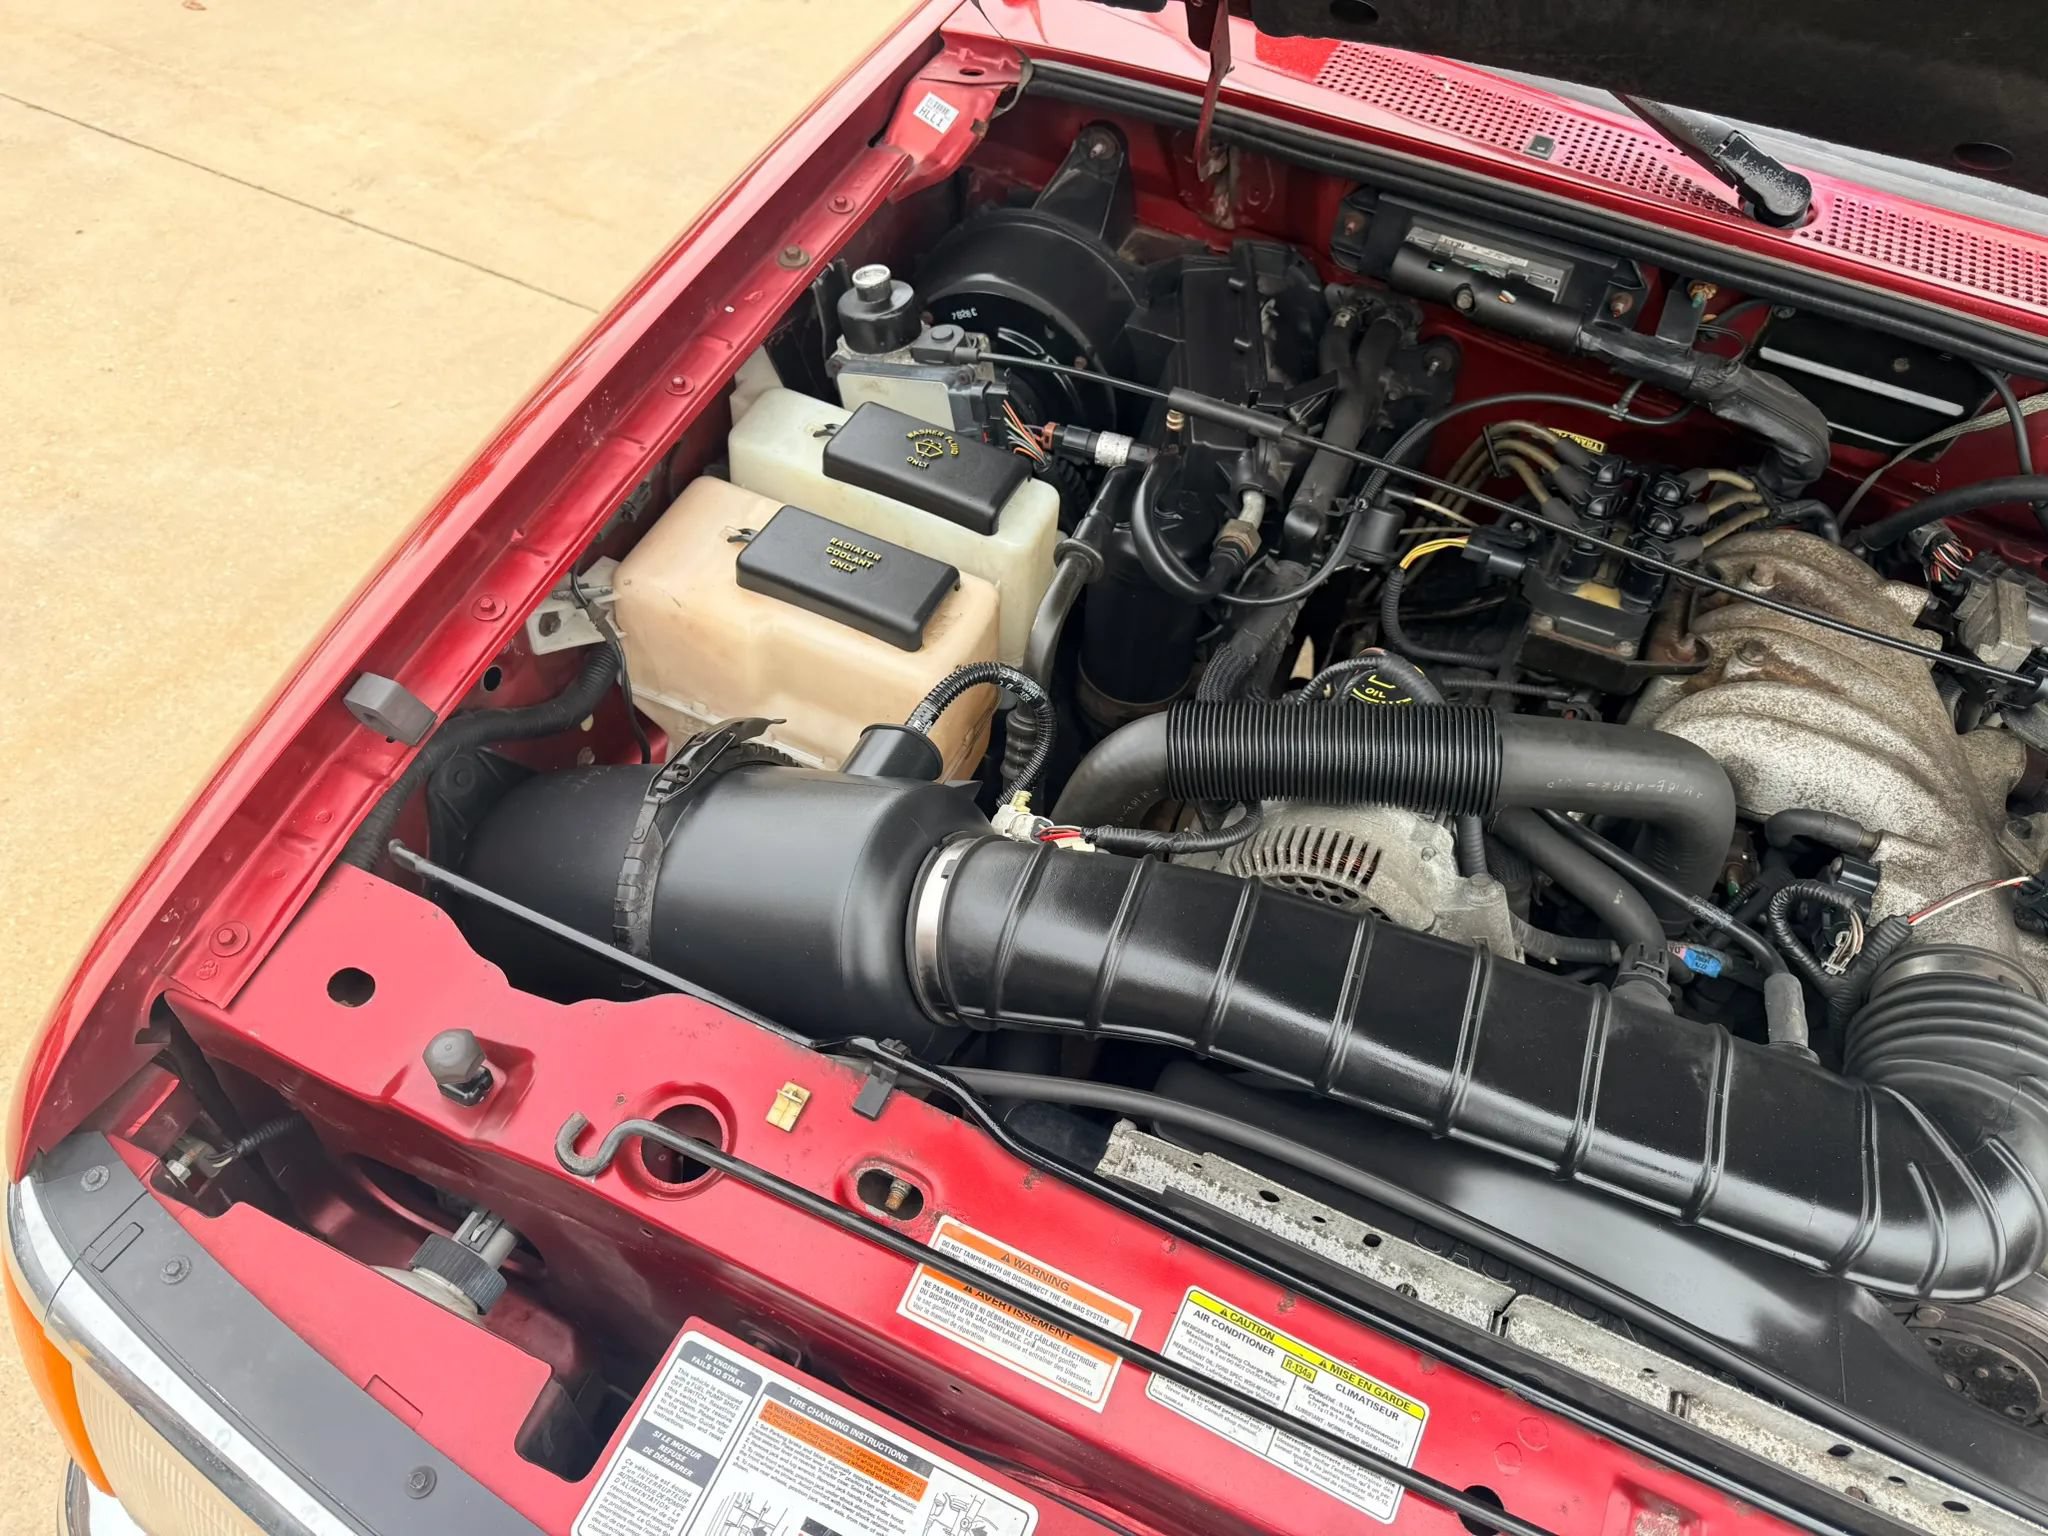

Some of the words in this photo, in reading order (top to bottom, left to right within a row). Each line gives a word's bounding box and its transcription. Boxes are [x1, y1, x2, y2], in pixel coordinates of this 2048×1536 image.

[906, 427, 945, 441] WASHER
[944, 434, 960, 456] FLUID
[906, 455, 930, 469] ONLY
[826, 547, 874, 569] COOLANT
[829, 537, 881, 562] RADIATOR
[830, 558, 857, 574] ONLY
[1364, 687, 1386, 698] OIL
[941, 1239, 950, 1248] DO
[950, 1243, 962, 1254] NOT
[962, 1249, 986, 1265] TAMPER
[985, 1260, 1002, 1273] WITH
[1002, 1268, 1012, 1278] OR
[1011, 1273, 1048, 1295] DISCONNECT
[1048, 1291, 1061, 1301] THE
[1060, 1297, 1072, 1307] AIR
[1072, 1302, 1085, 1313] BAG
[1084, 1309, 1110, 1325] SYSTEM
[1012, 1257, 1070, 1291] WARNING
[918, 1287, 928, 1296] OU
[928, 1291, 960, 1311] DISPOSITIF
[974, 1313, 987, 1324] SAC
[986, 1319, 1023, 1341] GONFLABLE.
[922, 1279, 932, 1288] NE
[931, 1283, 943, 1294] PAS
[943, 1289, 978, 1311] MANIPULER
[977, 1306, 986, 1314] NI
[985, 1308, 1026, 1334] DÉBRANCHER
[1025, 1329, 1034, 1337] LE
[975, 1289, 1072, 1341] AVERTISSEMENT
[1192, 1308, 1210, 1323] AIR
[1210, 1317, 1275, 1356] CONDITIONER
[1228, 1312, 1275, 1341] CAUTION
[690, 1355, 711, 1370] FAILS
[710, 1366, 722, 1376] TO
[721, 1371, 745, 1388] START
[704, 1353, 714, 1362] IF
[712, 1357, 740, 1375] ENGINE
[1284, 1358, 1313, 1379] R-134a
[1329, 1364, 1355, 1382] MISE
[1356, 1378, 1372, 1391] EN
[1373, 1386, 1410, 1410] GARDE
[1334, 1382, 1399, 1420] CLIMATISEUR
[651, 1429, 662, 1439] SI
[660, 1433, 672, 1444] LE
[669, 1438, 702, 1460] MOTEUR
[787, 1395, 808, 1410] TIRE
[806, 1405, 850, 1432] CHANGING
[848, 1427, 908, 1463] INSTRUCTIONS
[641, 1445, 654, 1455] DE
[652, 1450, 694, 1477] DÉMARRER
[657, 1443, 687, 1463] REFUSE
